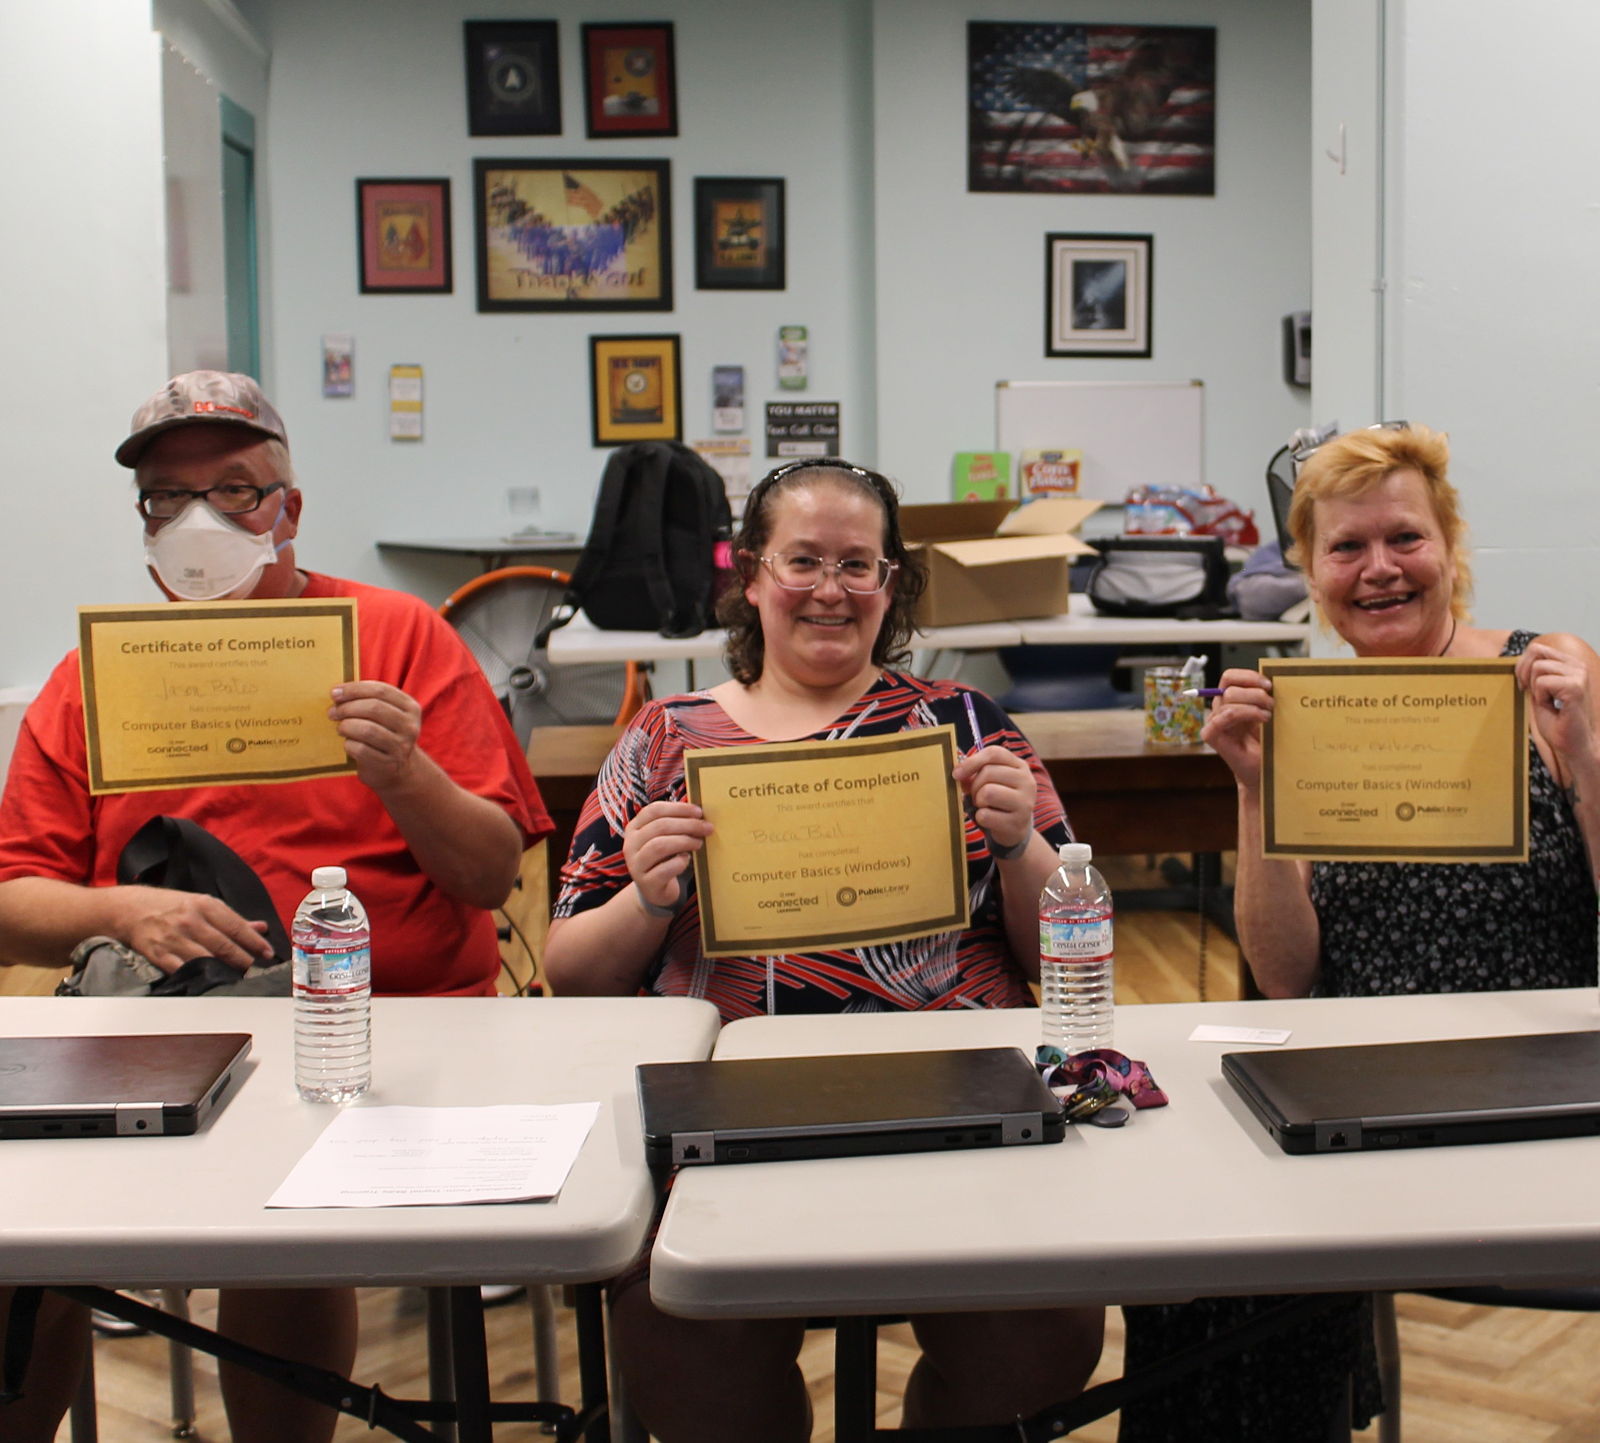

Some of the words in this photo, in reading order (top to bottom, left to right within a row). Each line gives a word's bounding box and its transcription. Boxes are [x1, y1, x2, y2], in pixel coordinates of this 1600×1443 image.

[768, 405, 792, 415] YOU
[795, 405, 837, 415] MATTER
[1031, 463, 1071, 475] Corn
[184, 568, 204, 578] 3M
[121, 640, 203, 654] Certificate
[207, 638, 223, 651] of
[228, 636, 316, 653] Completion
[169, 661, 186, 669] This
[188, 660, 213, 669] award
[214, 659, 248, 668] certifies
[250, 658, 268, 667] that
[1300, 695, 1378, 709] Certificate
[1382, 694, 1398, 708] of
[1402, 693, 1487, 710] Completion
[206, 704, 250, 714] completed
[121, 719, 186, 733] Computer
[191, 718, 231, 730] Basics
[234, 715, 303, 730] (Windows)
[1345, 716, 1361, 724] This
[1363, 716, 1387, 725] award
[1389, 715, 1422, 725] certifies
[1424, 715, 1440, 724] that
[147, 743, 208, 754] connected
[1378, 762, 1422, 773] completed
[728, 782, 809, 799] Certificate
[814, 778, 830, 792] of
[834, 770, 921, 792] Completion
[1296, 779, 1359, 793] Computer
[1363, 778, 1402, 791] Basics
[1405, 777, 1472, 792] (Windows)
[776, 804, 793, 813] This
[796, 801, 821, 811] award
[822, 799, 857, 810] certifies
[857, 796, 875, 806] that
[1319, 807, 1379, 818] connected
[798, 850, 814, 859] has
[815, 847, 860, 859] completed
[732, 868, 797, 884] Computer
[801, 865, 841, 879] Basics
[844, 855, 912, 877] (Windows)
[758, 895, 819, 909] connected
